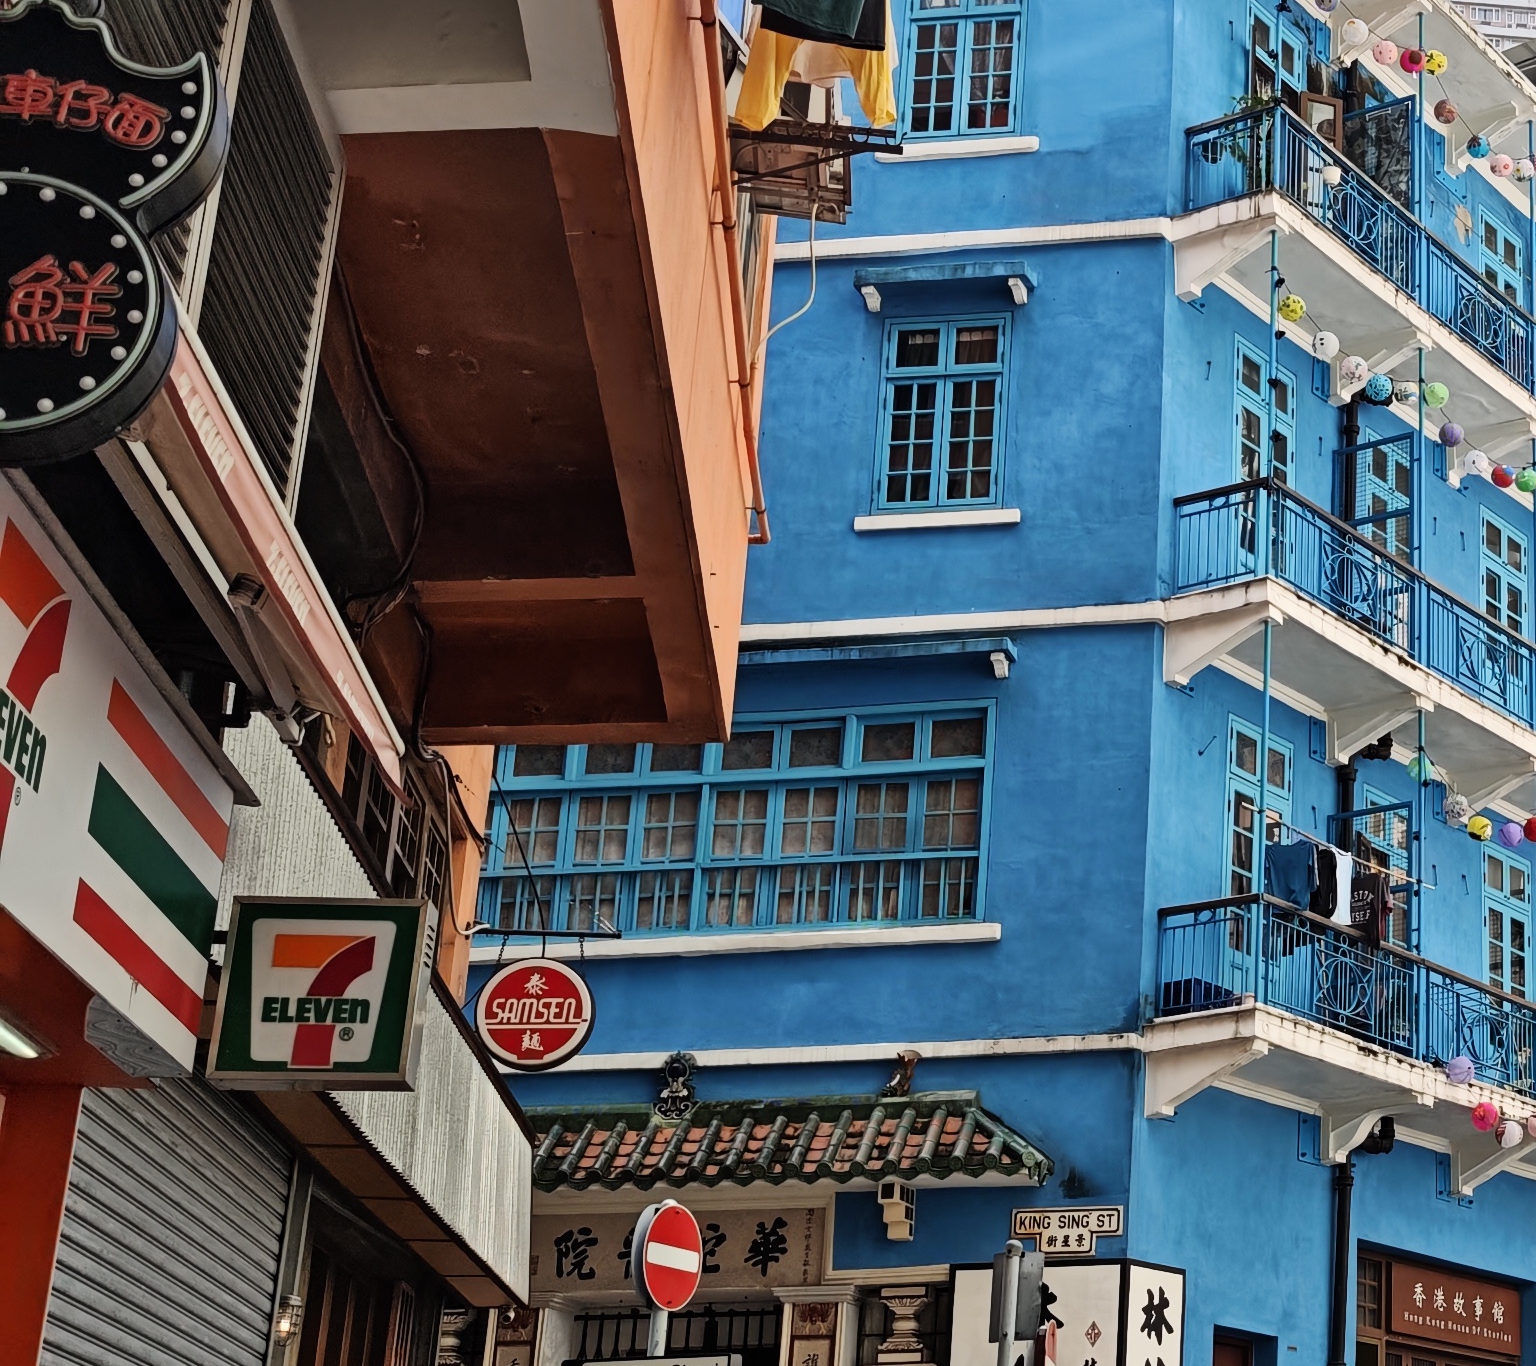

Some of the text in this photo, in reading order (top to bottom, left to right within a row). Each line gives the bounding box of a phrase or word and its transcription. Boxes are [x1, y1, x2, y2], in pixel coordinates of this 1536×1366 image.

[5, 254, 123, 355] 鮮
[524, 972, 550, 996] 泰
[486, 997, 588, 1025] SAMSEN
[1018, 1213, 1116, 1231] KING SING ST
[1404, 1311, 1423, 1325] Hong
[1425, 1316, 1445, 1330] Kong
